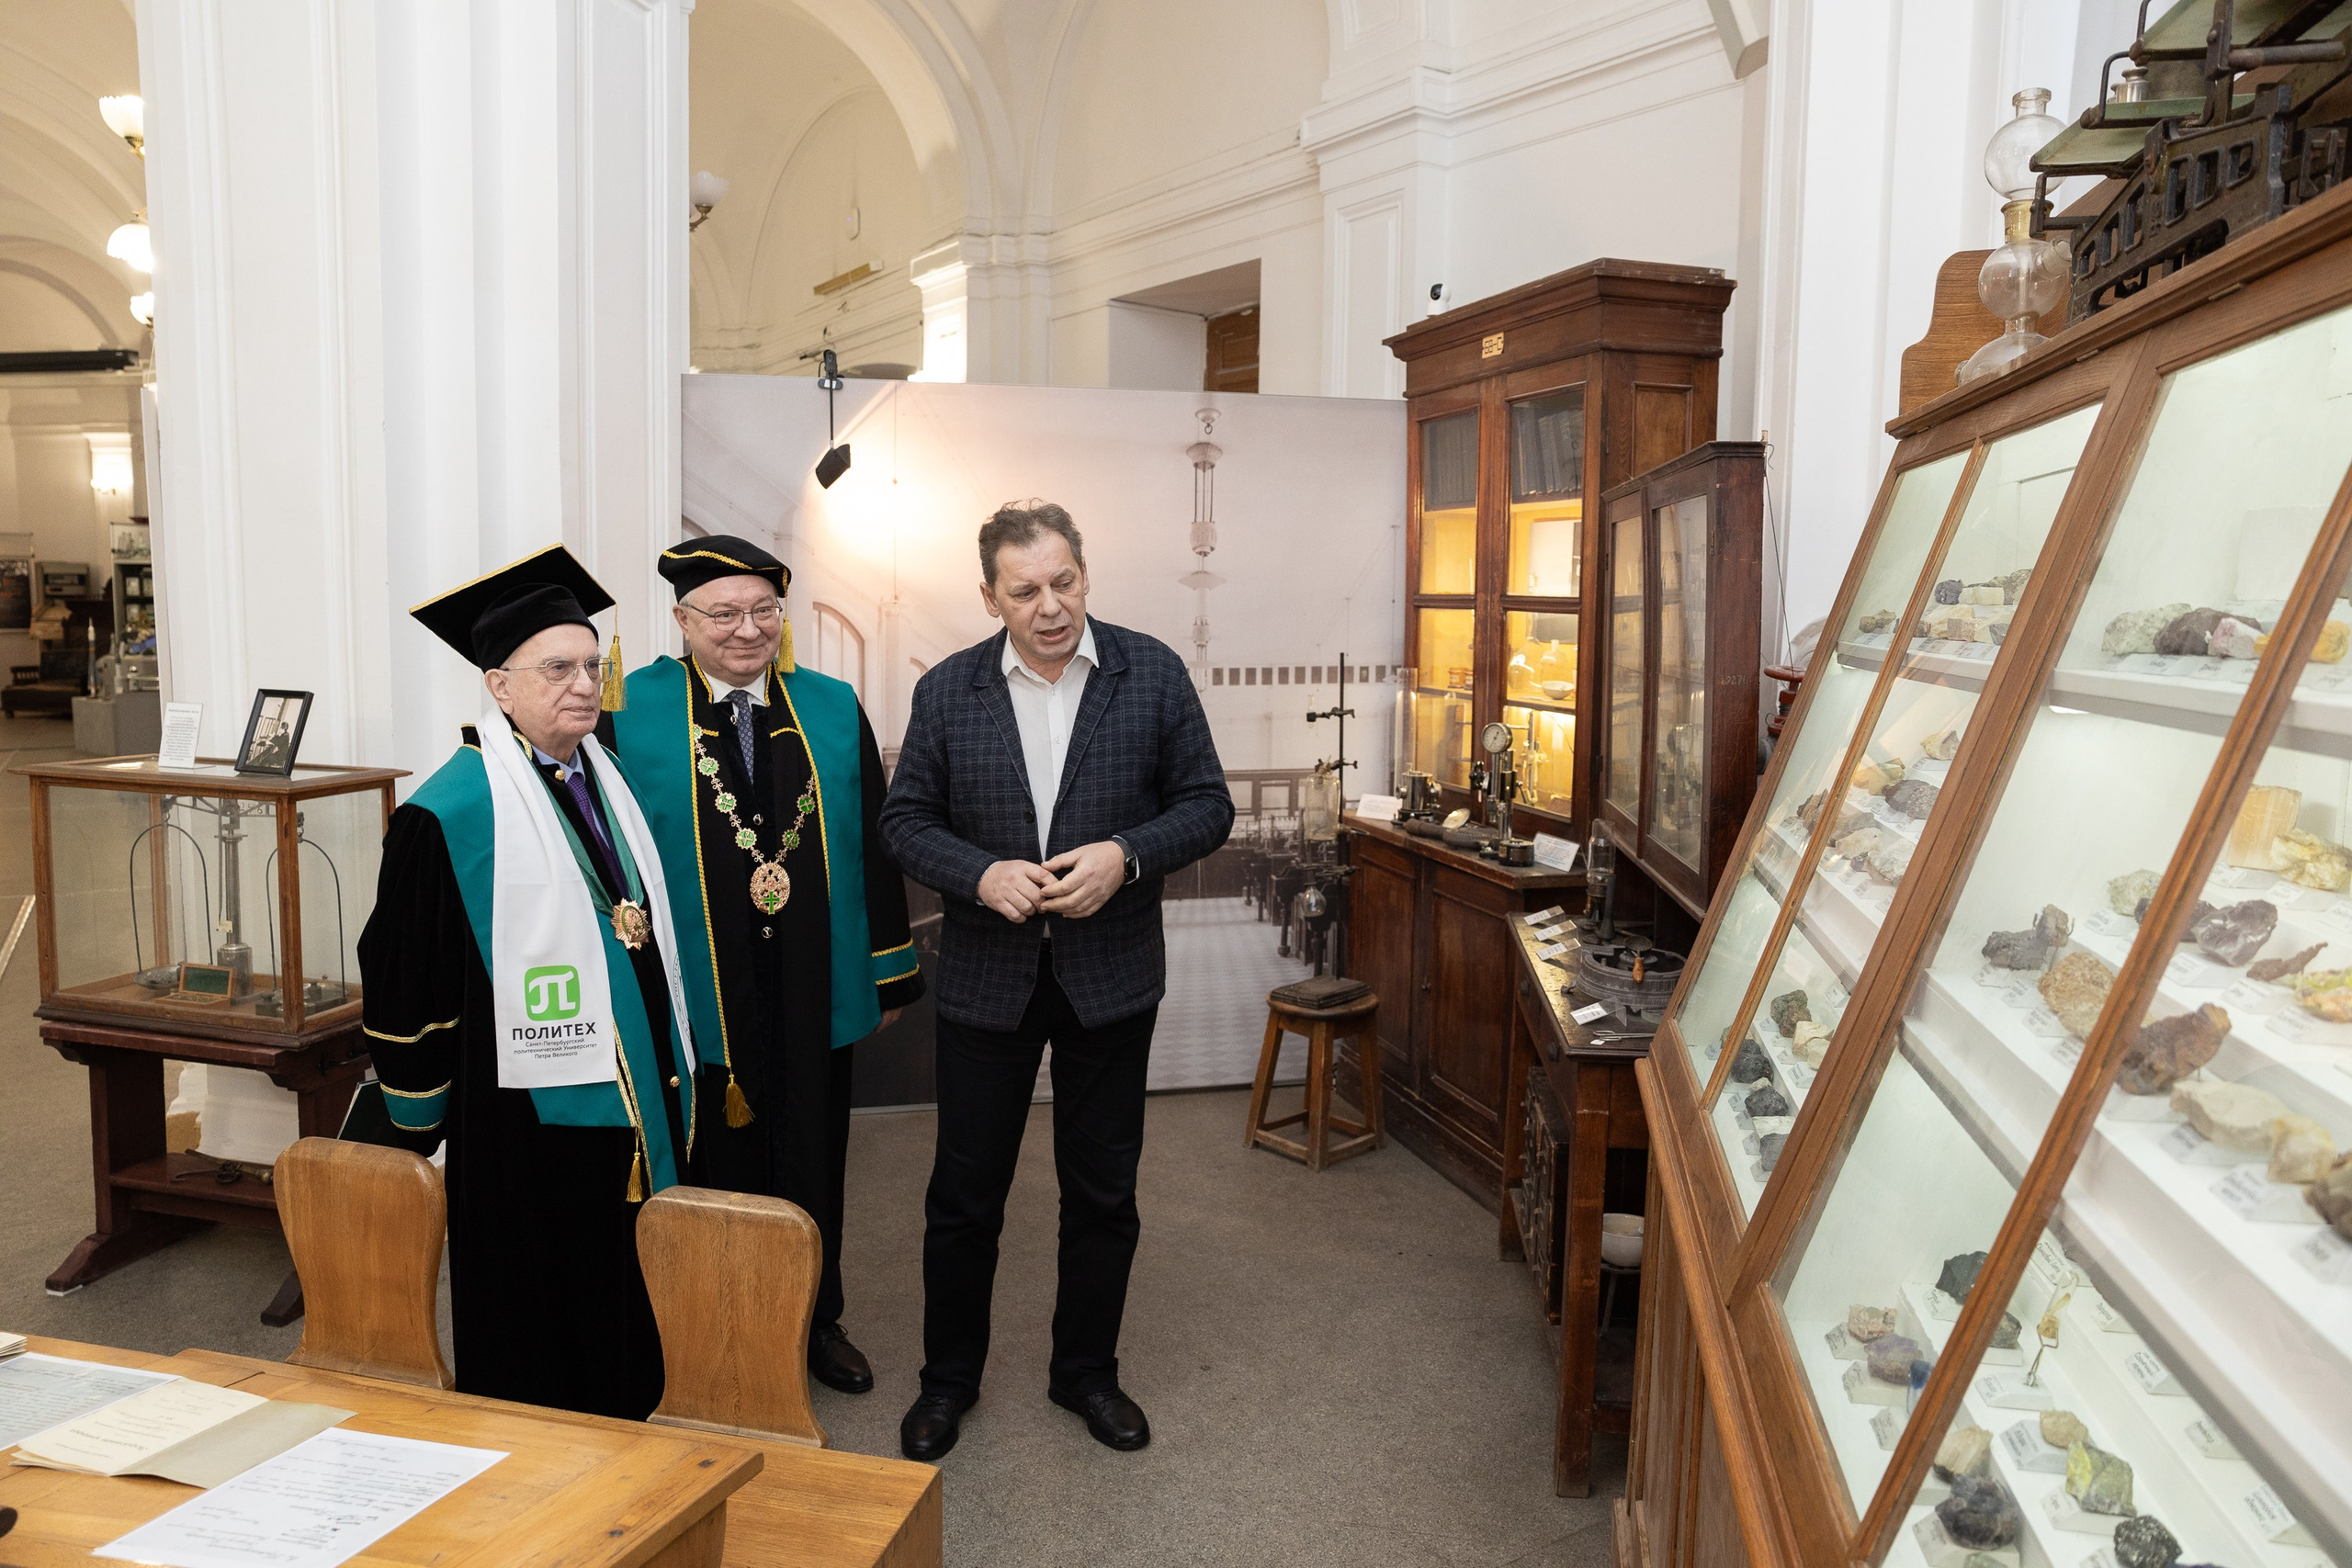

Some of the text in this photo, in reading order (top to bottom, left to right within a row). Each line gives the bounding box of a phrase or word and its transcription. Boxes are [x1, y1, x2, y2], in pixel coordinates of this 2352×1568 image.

[512, 1022, 597, 1041] ПОЛИТЕХ
[526, 1038, 585, 1048] Санкт-Петербургский
[514, 1046, 563, 1055] политехнический
